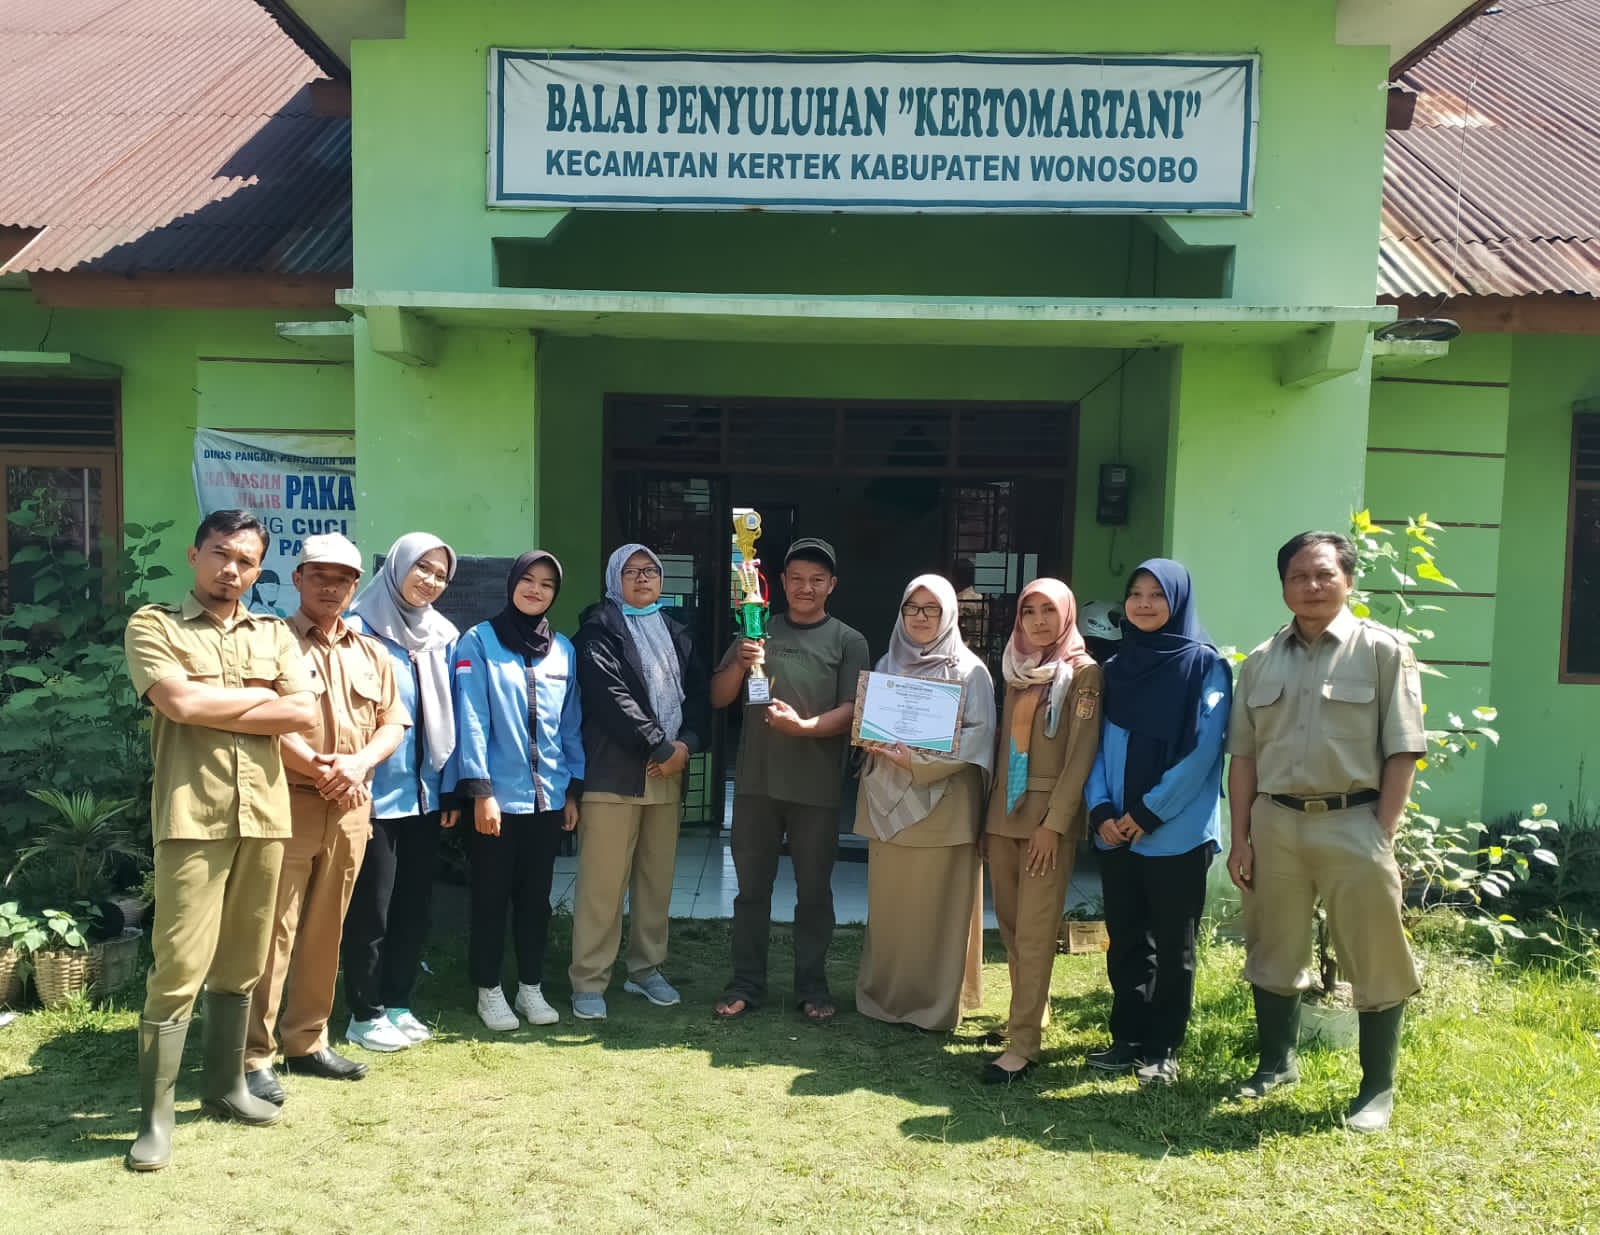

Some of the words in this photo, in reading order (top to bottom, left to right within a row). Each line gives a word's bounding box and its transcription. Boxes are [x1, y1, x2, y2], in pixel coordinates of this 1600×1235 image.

[546, 83, 649, 134] BALAI
[657, 85, 889, 137] PENYULUHAN
[546, 149, 718, 179] KECAMATAN
[728, 151, 841, 180] KERTEK
[850, 153, 1021, 182] KABUPATEN
[1030, 155, 1199, 184] WONOSOBO
[204, 449, 231, 459] DINAS
[292, 519, 347, 535] CUCI
